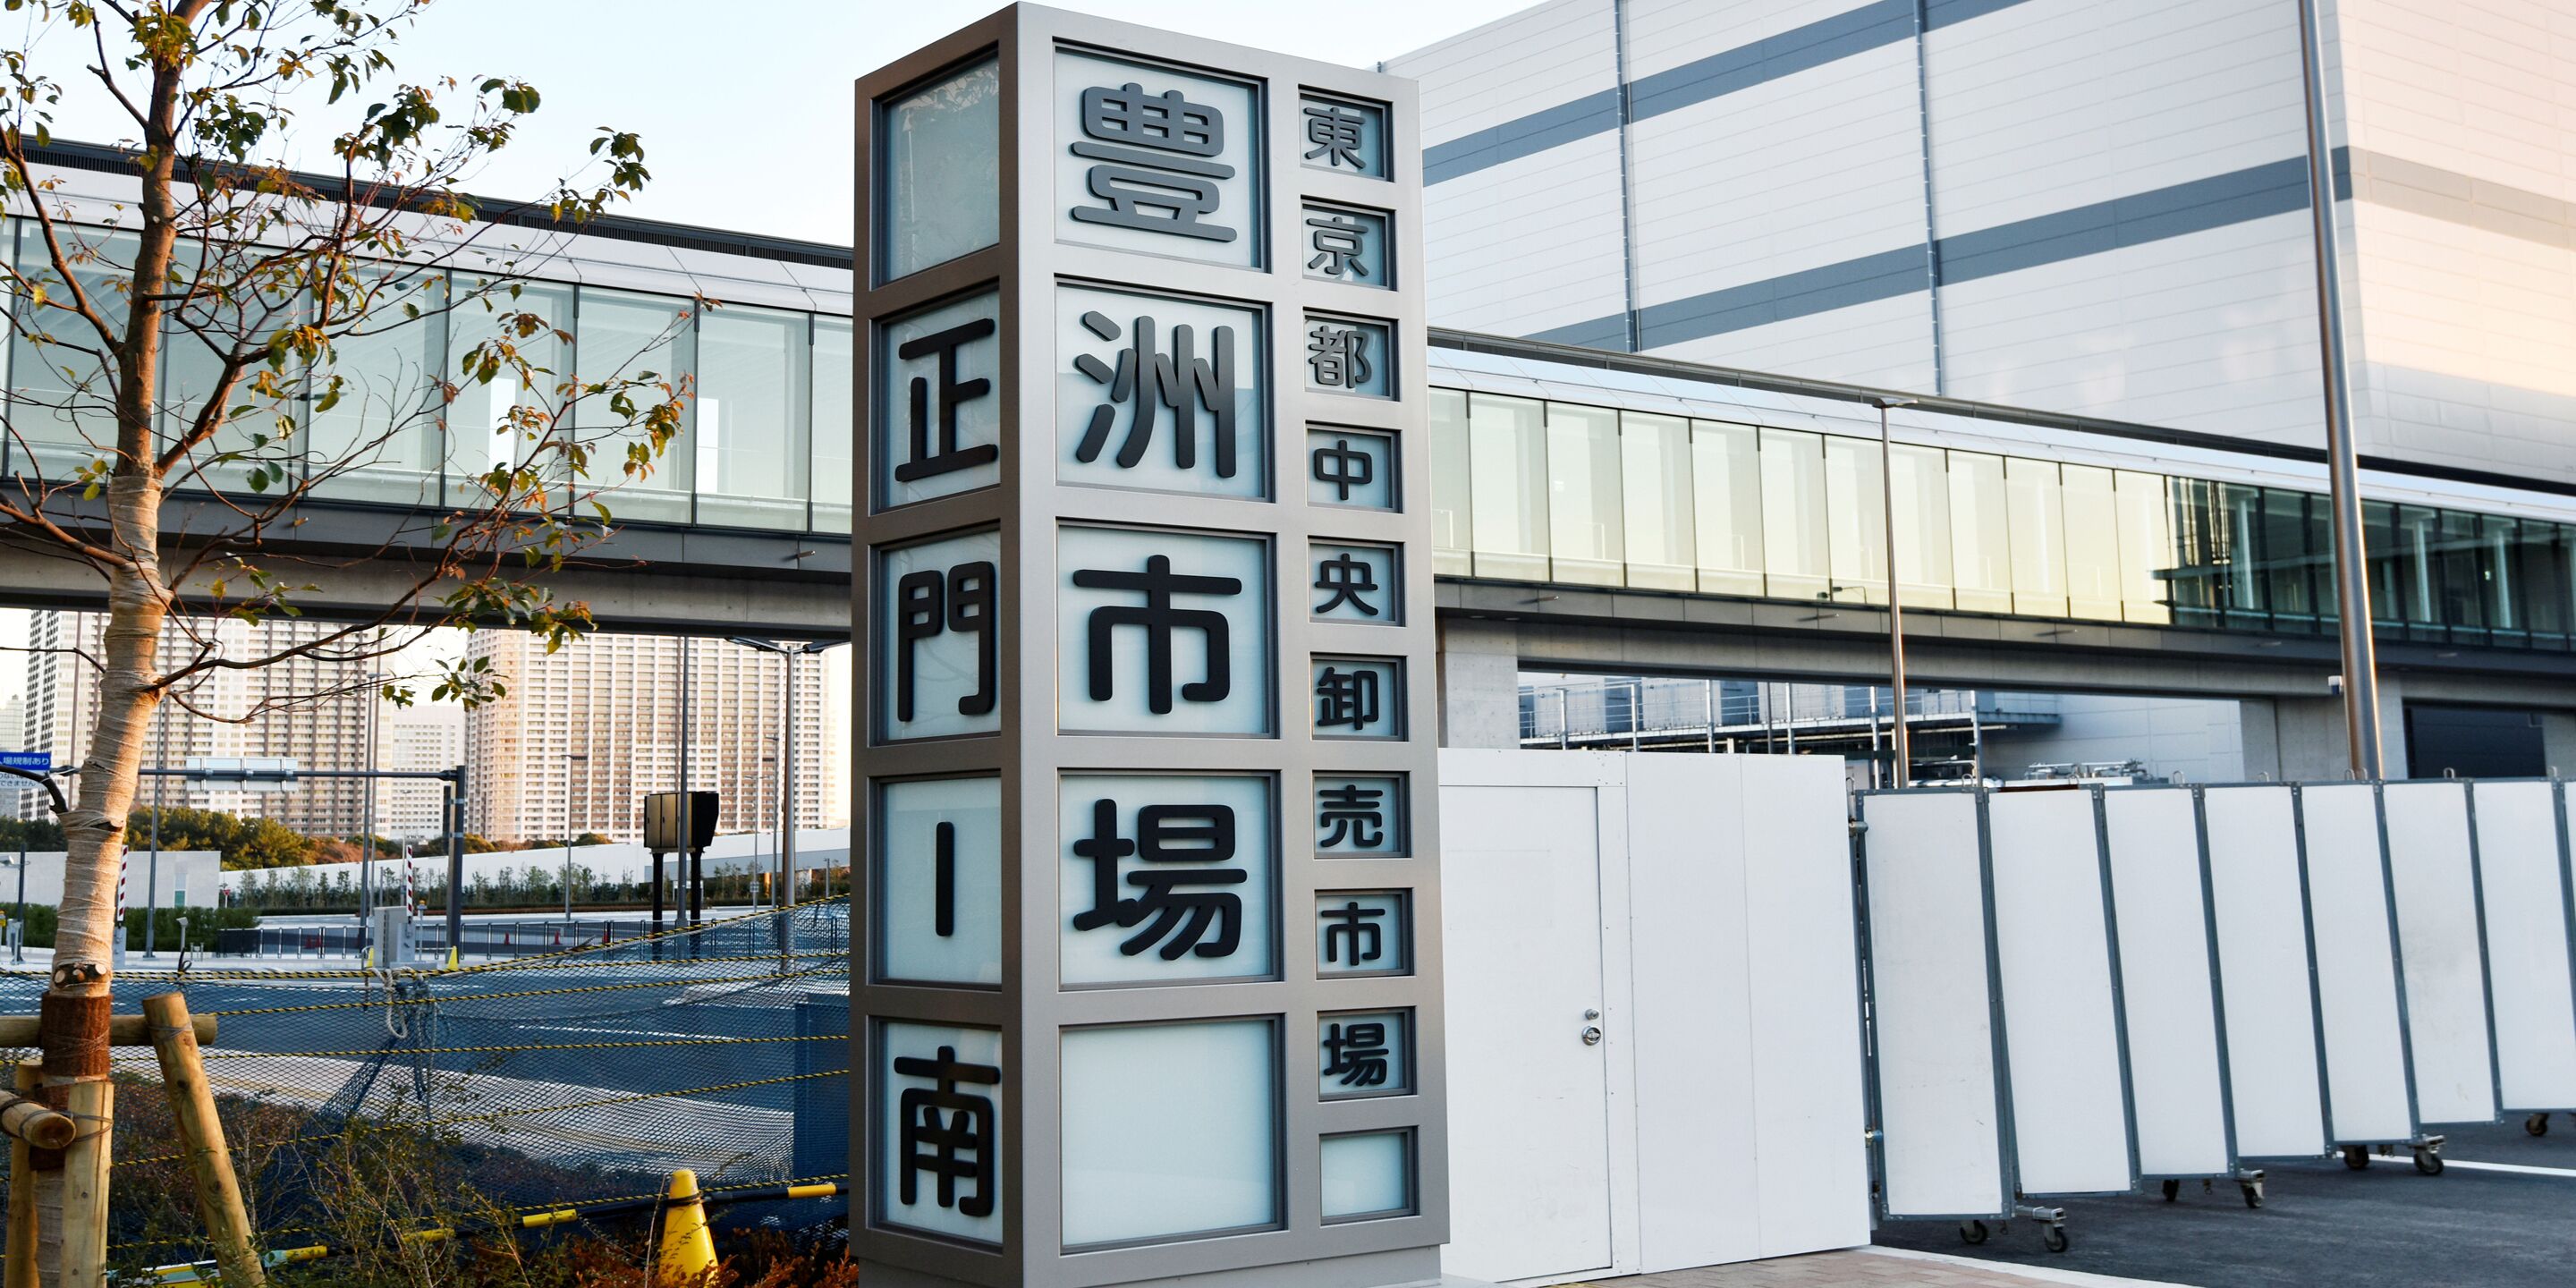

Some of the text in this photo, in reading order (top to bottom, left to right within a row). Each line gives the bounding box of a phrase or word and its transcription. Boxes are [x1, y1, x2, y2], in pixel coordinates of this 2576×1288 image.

[0, 756, 49, 766] 場規制あり
[1070, 82, 1248, 961] 豊洲市場
[1302, 106, 1389, 1087] 東京都中央卸売市場
